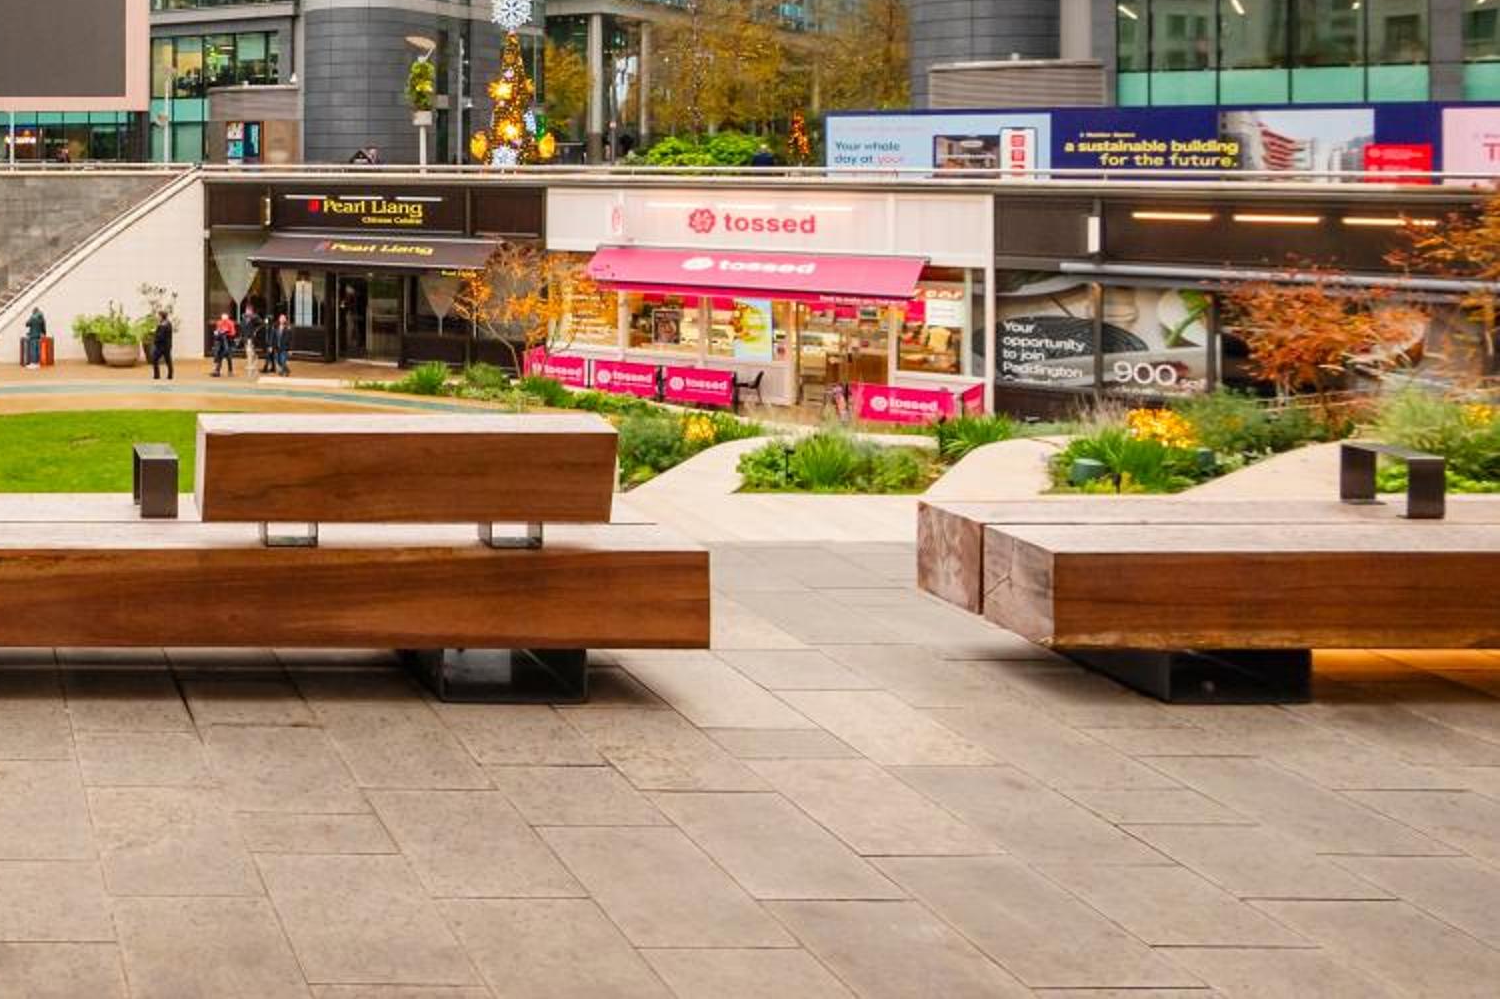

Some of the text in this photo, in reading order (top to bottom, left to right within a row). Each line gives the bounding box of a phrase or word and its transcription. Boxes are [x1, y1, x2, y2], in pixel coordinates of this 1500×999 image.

[863, 140, 900, 151] whole
[1064, 138, 1239, 156] a sustainable building
[834, 152, 856, 165] day
[859, 154, 874, 164] at
[1100, 152, 1238, 168] for the future.
[323, 200, 423, 218] Pearl Liang
[724, 214, 816, 234] tossed
[331, 242, 433, 256] Pearl Liang
[719, 257, 816, 275] tossed
[1003, 321, 1036, 333] Your
[1002, 335, 1086, 353] opportunity
[1003, 348, 1045, 362] to join
[612, 370, 653, 383] tossed
[1003, 361, 1084, 379] Paddington
[1113, 360, 1177, 386] 900
[685, 377, 728, 390] tossed
[889, 397, 939, 411] tossed
